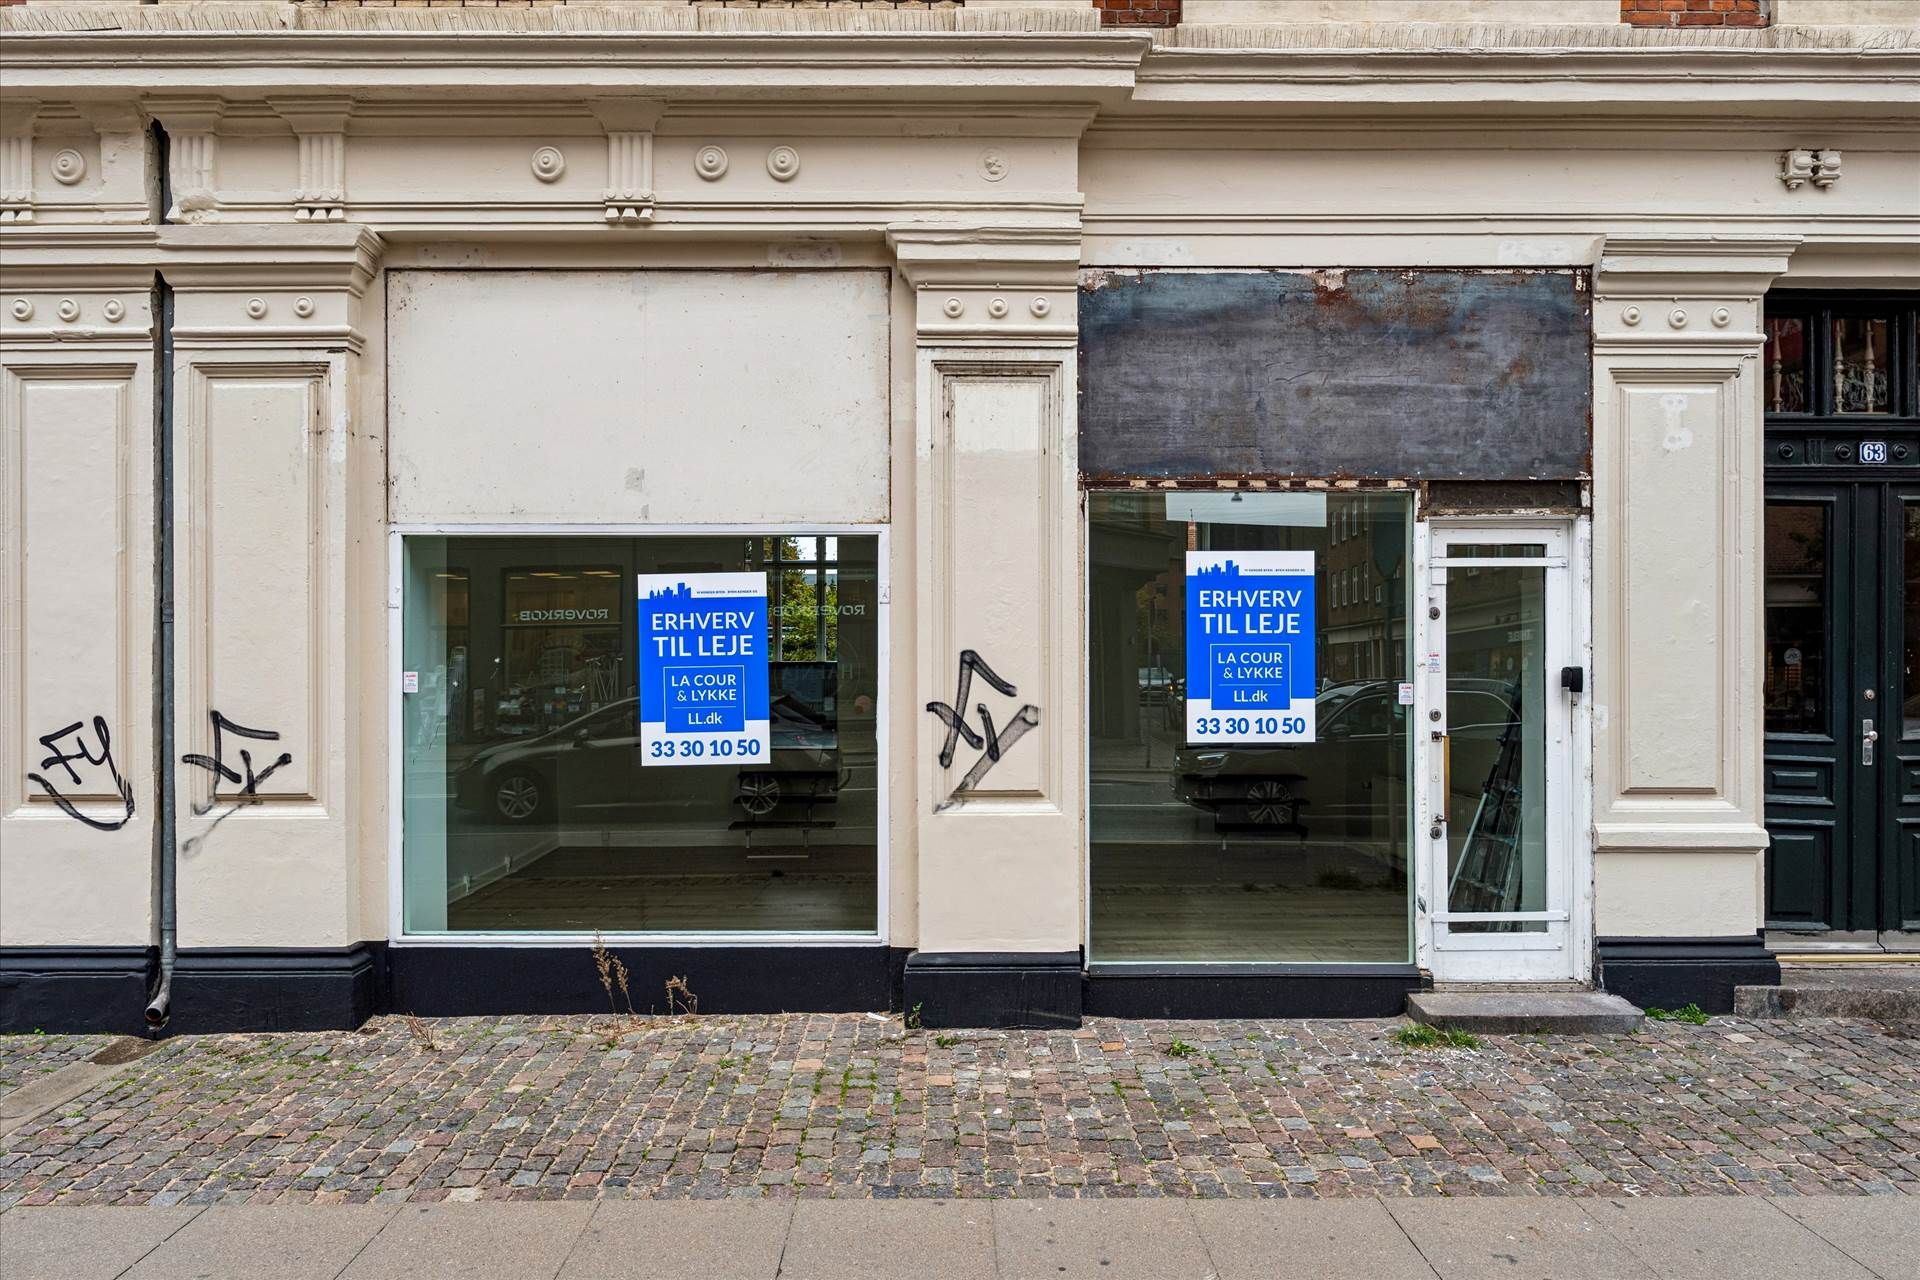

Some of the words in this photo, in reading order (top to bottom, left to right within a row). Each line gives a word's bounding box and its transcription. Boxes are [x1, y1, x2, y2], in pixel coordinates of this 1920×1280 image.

[1863, 444, 1884, 461] 63
[1199, 590, 1302, 608] ERHVERV
[652, 611, 755, 631] ERHVERV
[1199, 613, 1238, 634] TIL
[1245, 613, 1300, 634] LEJE
[652, 636, 692, 657] TIL
[698, 634, 754, 656] LEJE
[1217, 652, 1236, 664] LA
[1240, 652, 1283, 664] COUR
[671, 675, 691, 687] LA
[693, 674, 737, 686] COUR
[1223, 667, 1233, 679] &
[1237, 667, 1283, 679] LYKKE
[677, 690, 687, 702] &
[691, 689, 737, 701] LYKKE
[1233, 689, 1268, 702] LL.dk
[687, 711, 723, 725] LL.dk
[1196, 717, 1221, 735] 33
[1225, 717, 1250, 735] 30
[1255, 717, 1278, 735] 10
[1281, 717, 1306, 735] 50
[651, 740, 675, 758] 33
[680, 739, 704, 757] 30
[709, 739, 733, 757] 10
[736, 738, 761, 756] 50
